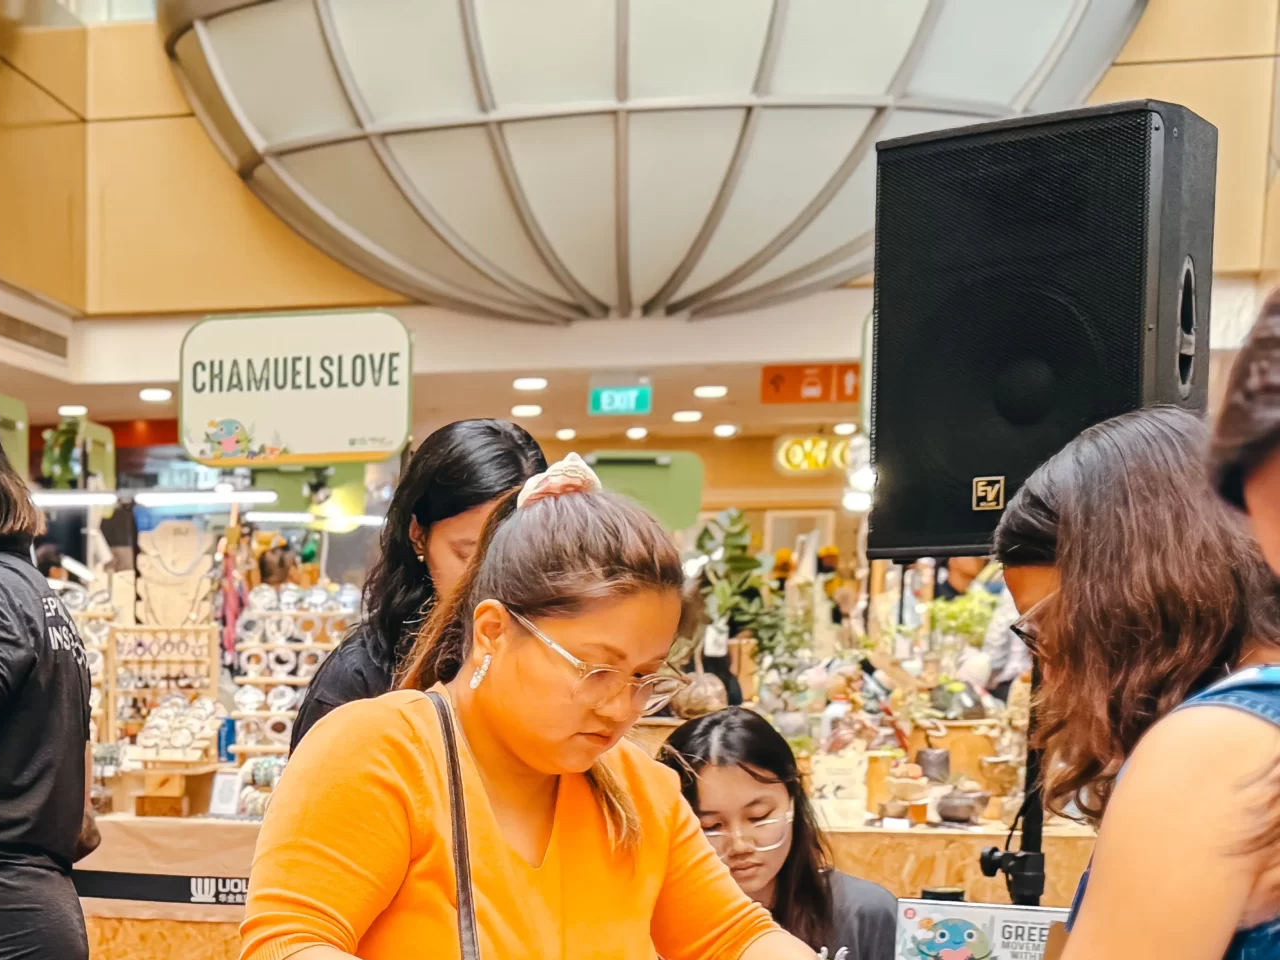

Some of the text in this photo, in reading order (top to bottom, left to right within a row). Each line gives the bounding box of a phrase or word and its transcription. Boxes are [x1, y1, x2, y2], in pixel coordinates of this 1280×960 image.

[192, 352, 400, 394] CHAMUELSLOVE
[600, 388, 639, 412] EXIT
[218, 879, 248, 893] UOL
[1001, 941, 1046, 952] MOVEM
[1010, 950, 1037, 960] WITH
